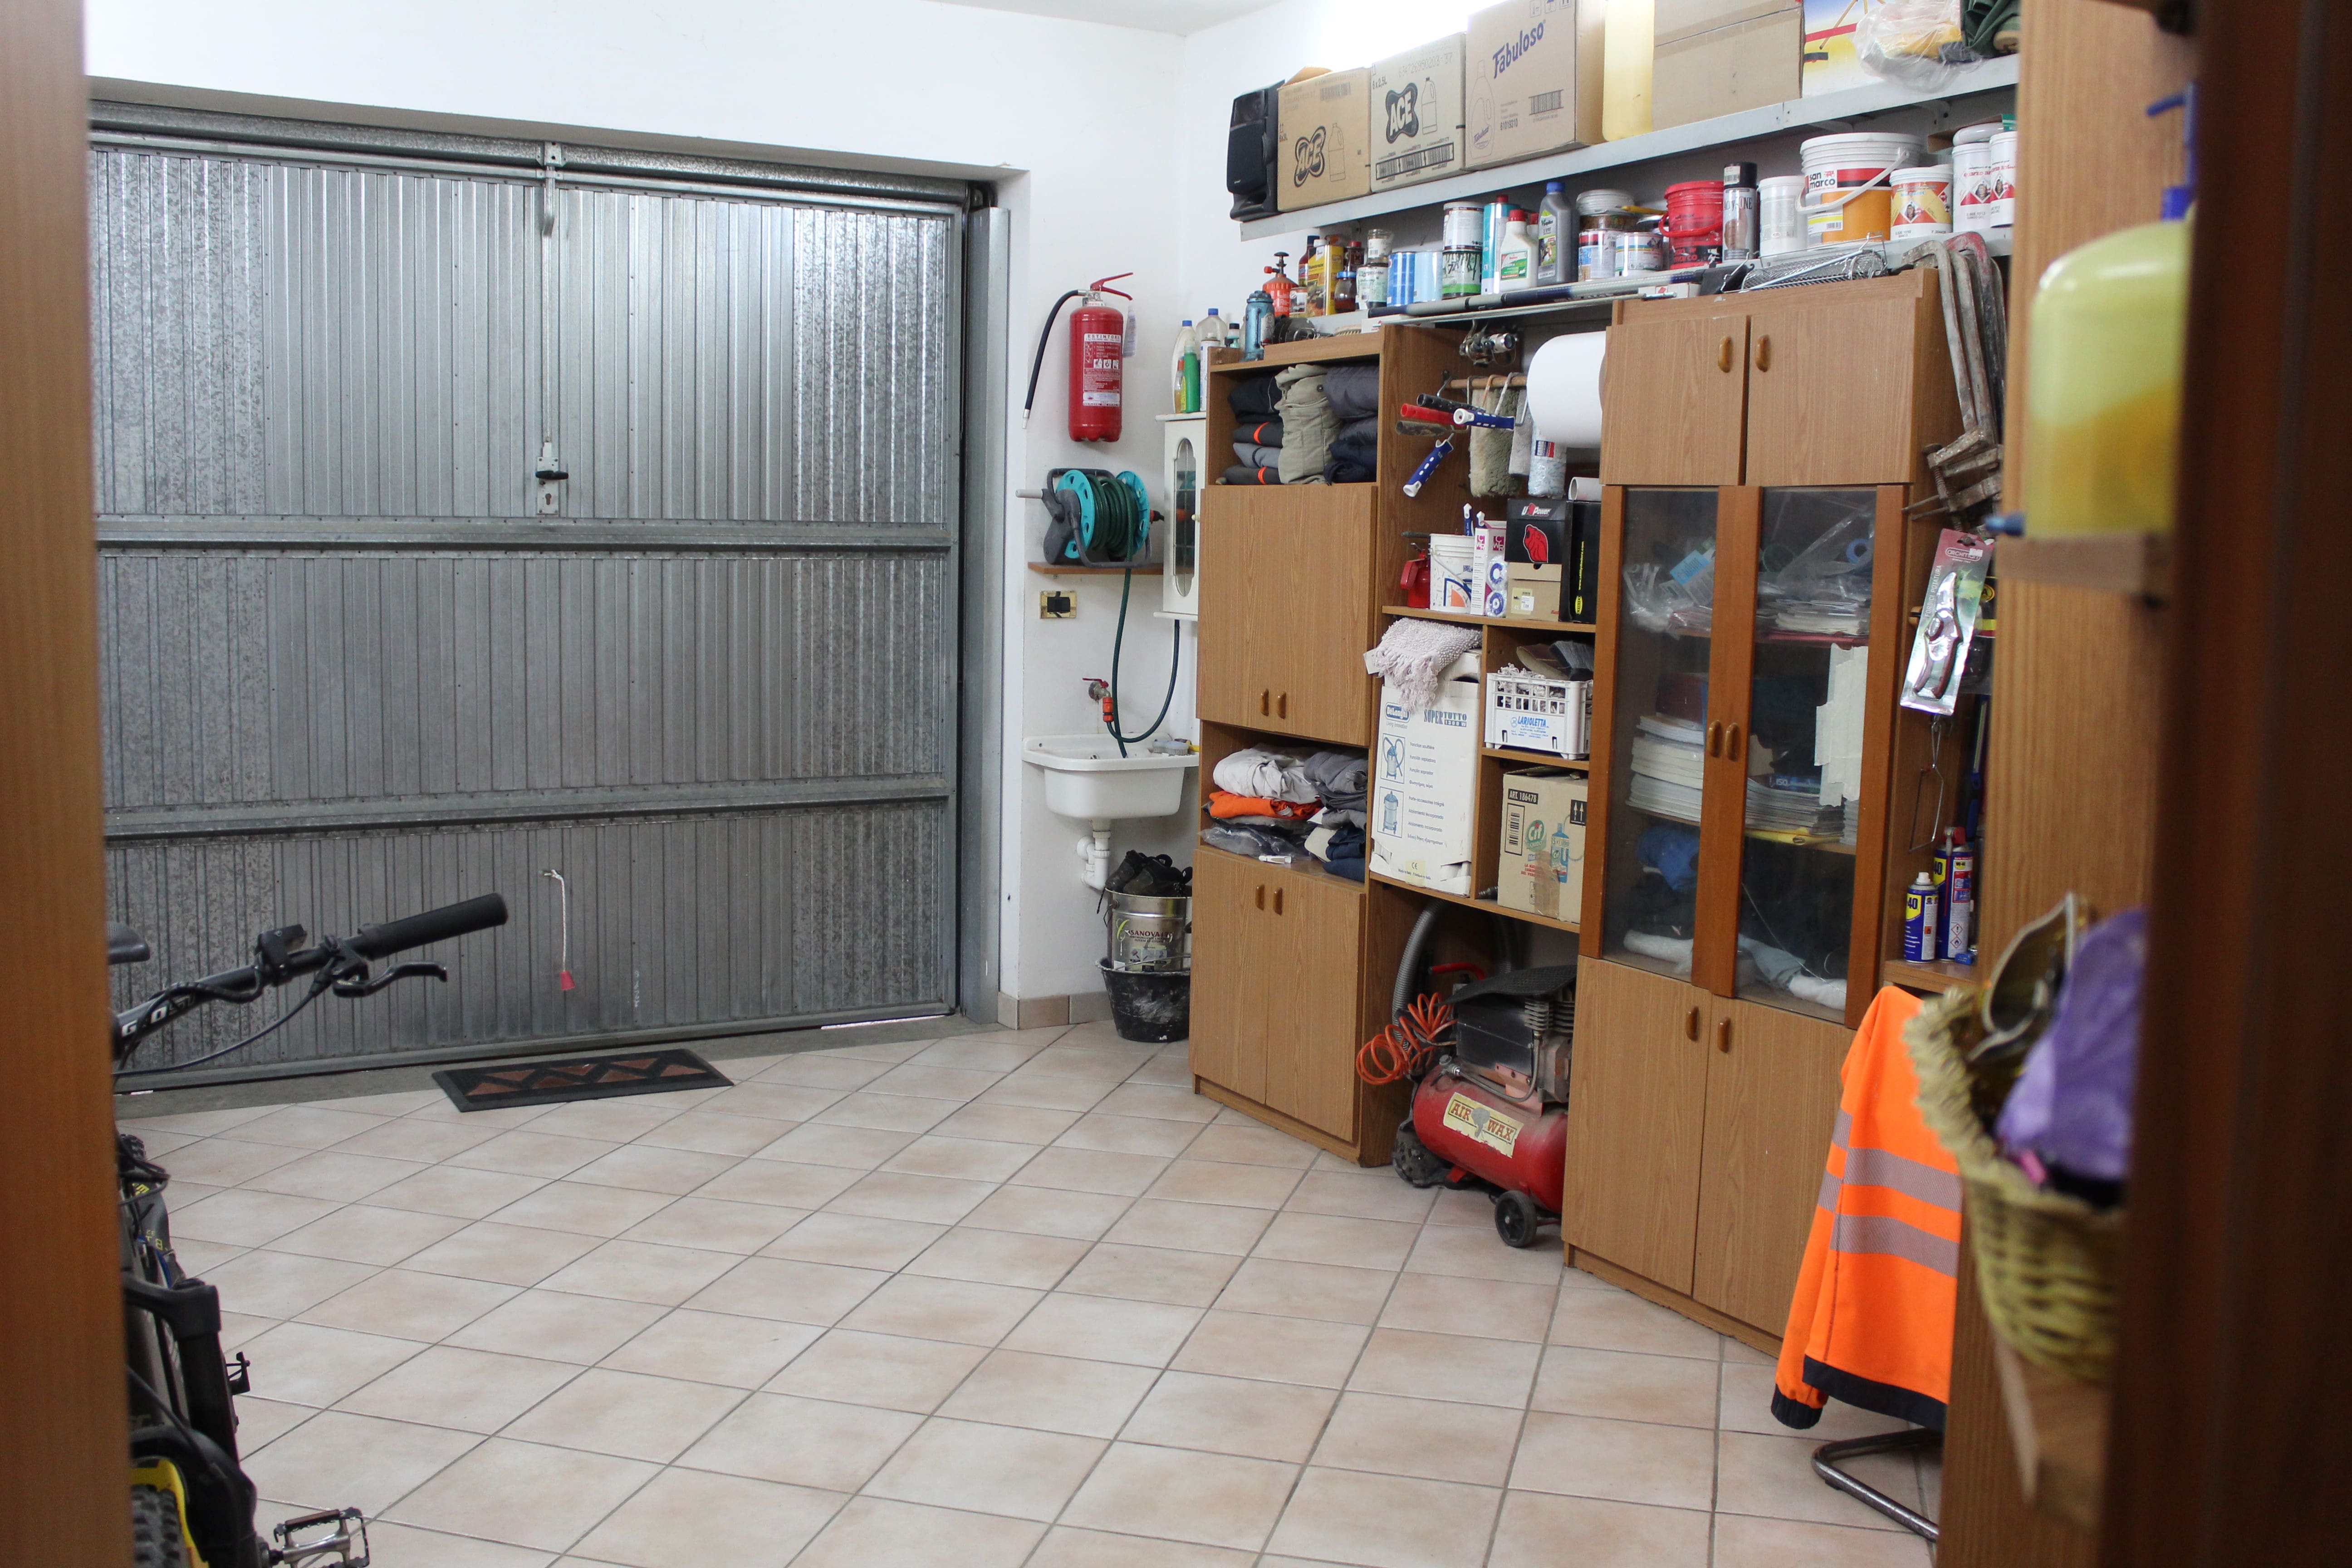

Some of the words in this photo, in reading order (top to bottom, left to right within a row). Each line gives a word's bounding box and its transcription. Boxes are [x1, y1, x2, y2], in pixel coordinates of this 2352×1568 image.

[1493, 22, 1544, 79] Fabuloso
[1390, 91, 1412, 136] ACE
[1296, 135, 1323, 176] ACE
[1809, 172, 1822, 181] san
[1809, 179, 1836, 189] marco
[1532, 506, 1552, 516] Power
[1925, 594, 1935, 617] FORBICI
[1931, 565, 1942, 593] POTATURA
[1424, 709, 1443, 725] SUPER
[1443, 711, 1467, 721] TUTTO
[1518, 716, 1546, 728] LARIOLETTA
[1519, 792, 1537, 803] 186478
[1450, 1102, 1472, 1121] AIR
[1487, 1119, 1514, 1141] WAX
